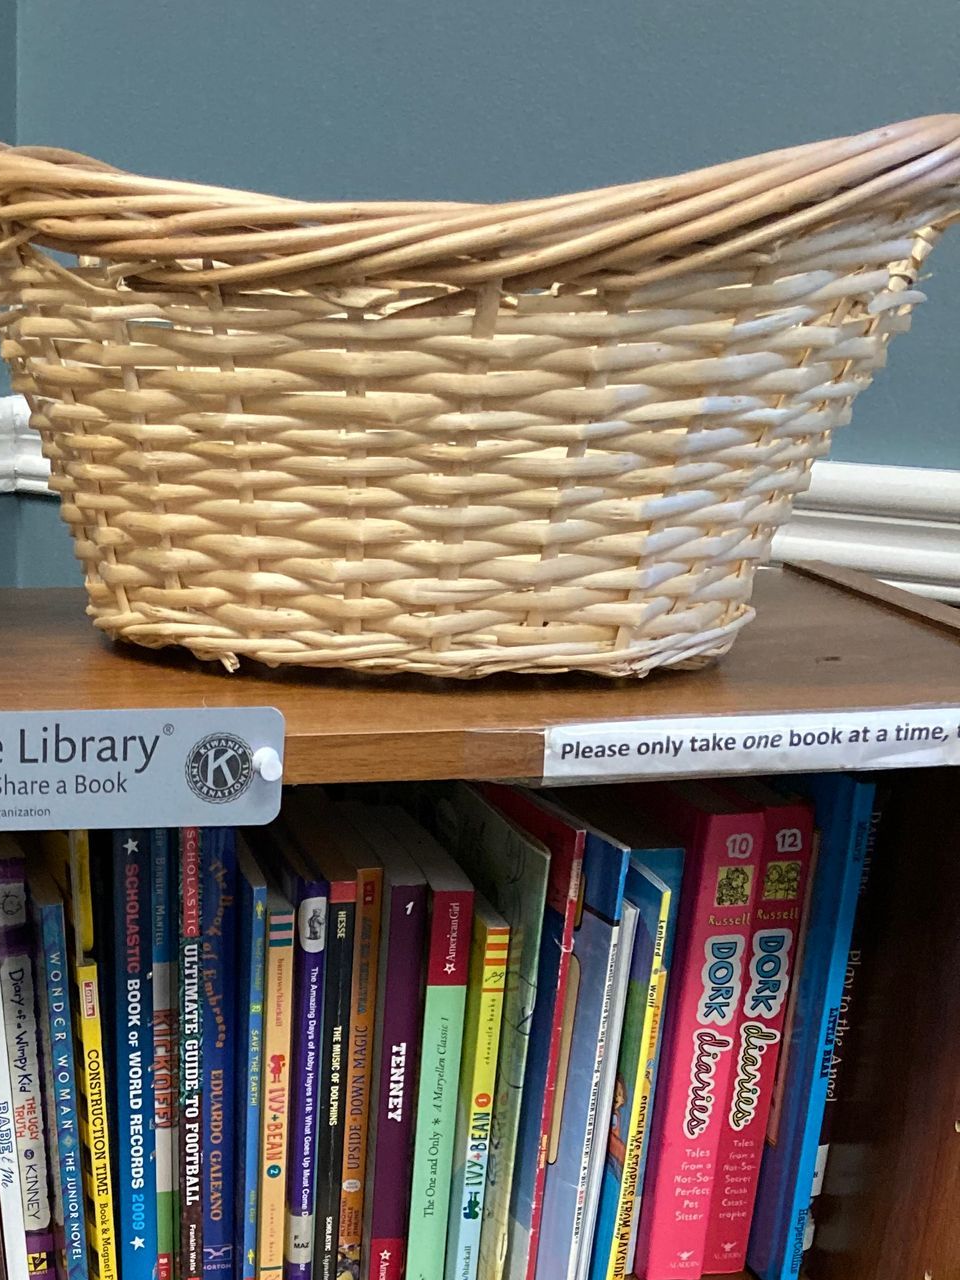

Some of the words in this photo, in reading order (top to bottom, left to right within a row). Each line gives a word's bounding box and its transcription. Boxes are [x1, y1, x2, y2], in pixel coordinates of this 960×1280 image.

[199, 740, 244, 755] KIWANIS
[561, 741, 629, 760] Please
[637, 736, 682, 757] only
[690, 733, 736, 753] take
[743, 733, 782, 750] one
[789, 727, 841, 748] book
[848, 727, 870, 743] at
[876, 729, 887, 742] a
[895, 723, 949, 743] time,
[56, 781, 67, 795] a
[74, 772, 128, 795] Book
[192, 762, 249, 798] INTERNATIONAL
[207, 748, 235, 789] K
[186, 830, 196, 934] SCHOLASTIC
[126, 864, 140, 973] SCHOLASTIC
[336, 911, 346, 939] HESSE
[184, 944, 200, 1034] ULTIMATE
[702, 941, 738, 1018] DORK
[750, 935, 785, 1012] DORK
[50, 952, 66, 1042] WONDER
[127, 980, 140, 1028] BOOK
[128, 1032, 138, 1047] OF
[332, 1026, 342, 1042] THE
[184, 1040, 200, 1090] GUIDE
[331, 1044, 342, 1070] MUSIC
[331, 1072, 340, 1083] OF
[732, 1026, 777, 1128] diaries
[128, 1051, 142, 1110] WORLD
[387, 1042, 406, 1122] TENNEY
[686, 1032, 730, 1136] diaries
[87, 1049, 106, 1160] CONSTRUCTION
[186, 1098, 200, 1118] TO
[210, 1070, 223, 1144] EDUARDO
[328, 1086, 340, 1126] DOLPHINS
[64, 1151, 76, 1172] THE
[130, 1114, 144, 1189] RECORDS
[185, 1122, 200, 1206] FOOTBALL
[0, 1168, 14, 1190] Me
[67, 1177, 80, 1219] JUNIOR
[96, 1163, 109, 1196] TIME
[210, 1150, 222, 1220] GALEANO
[98, 1202, 110, 1226] Book
[131, 1194, 144, 1230] 2009
[70, 1224, 82, 1260] NOVEL
[100, 1237, 112, 1272] Magnet
